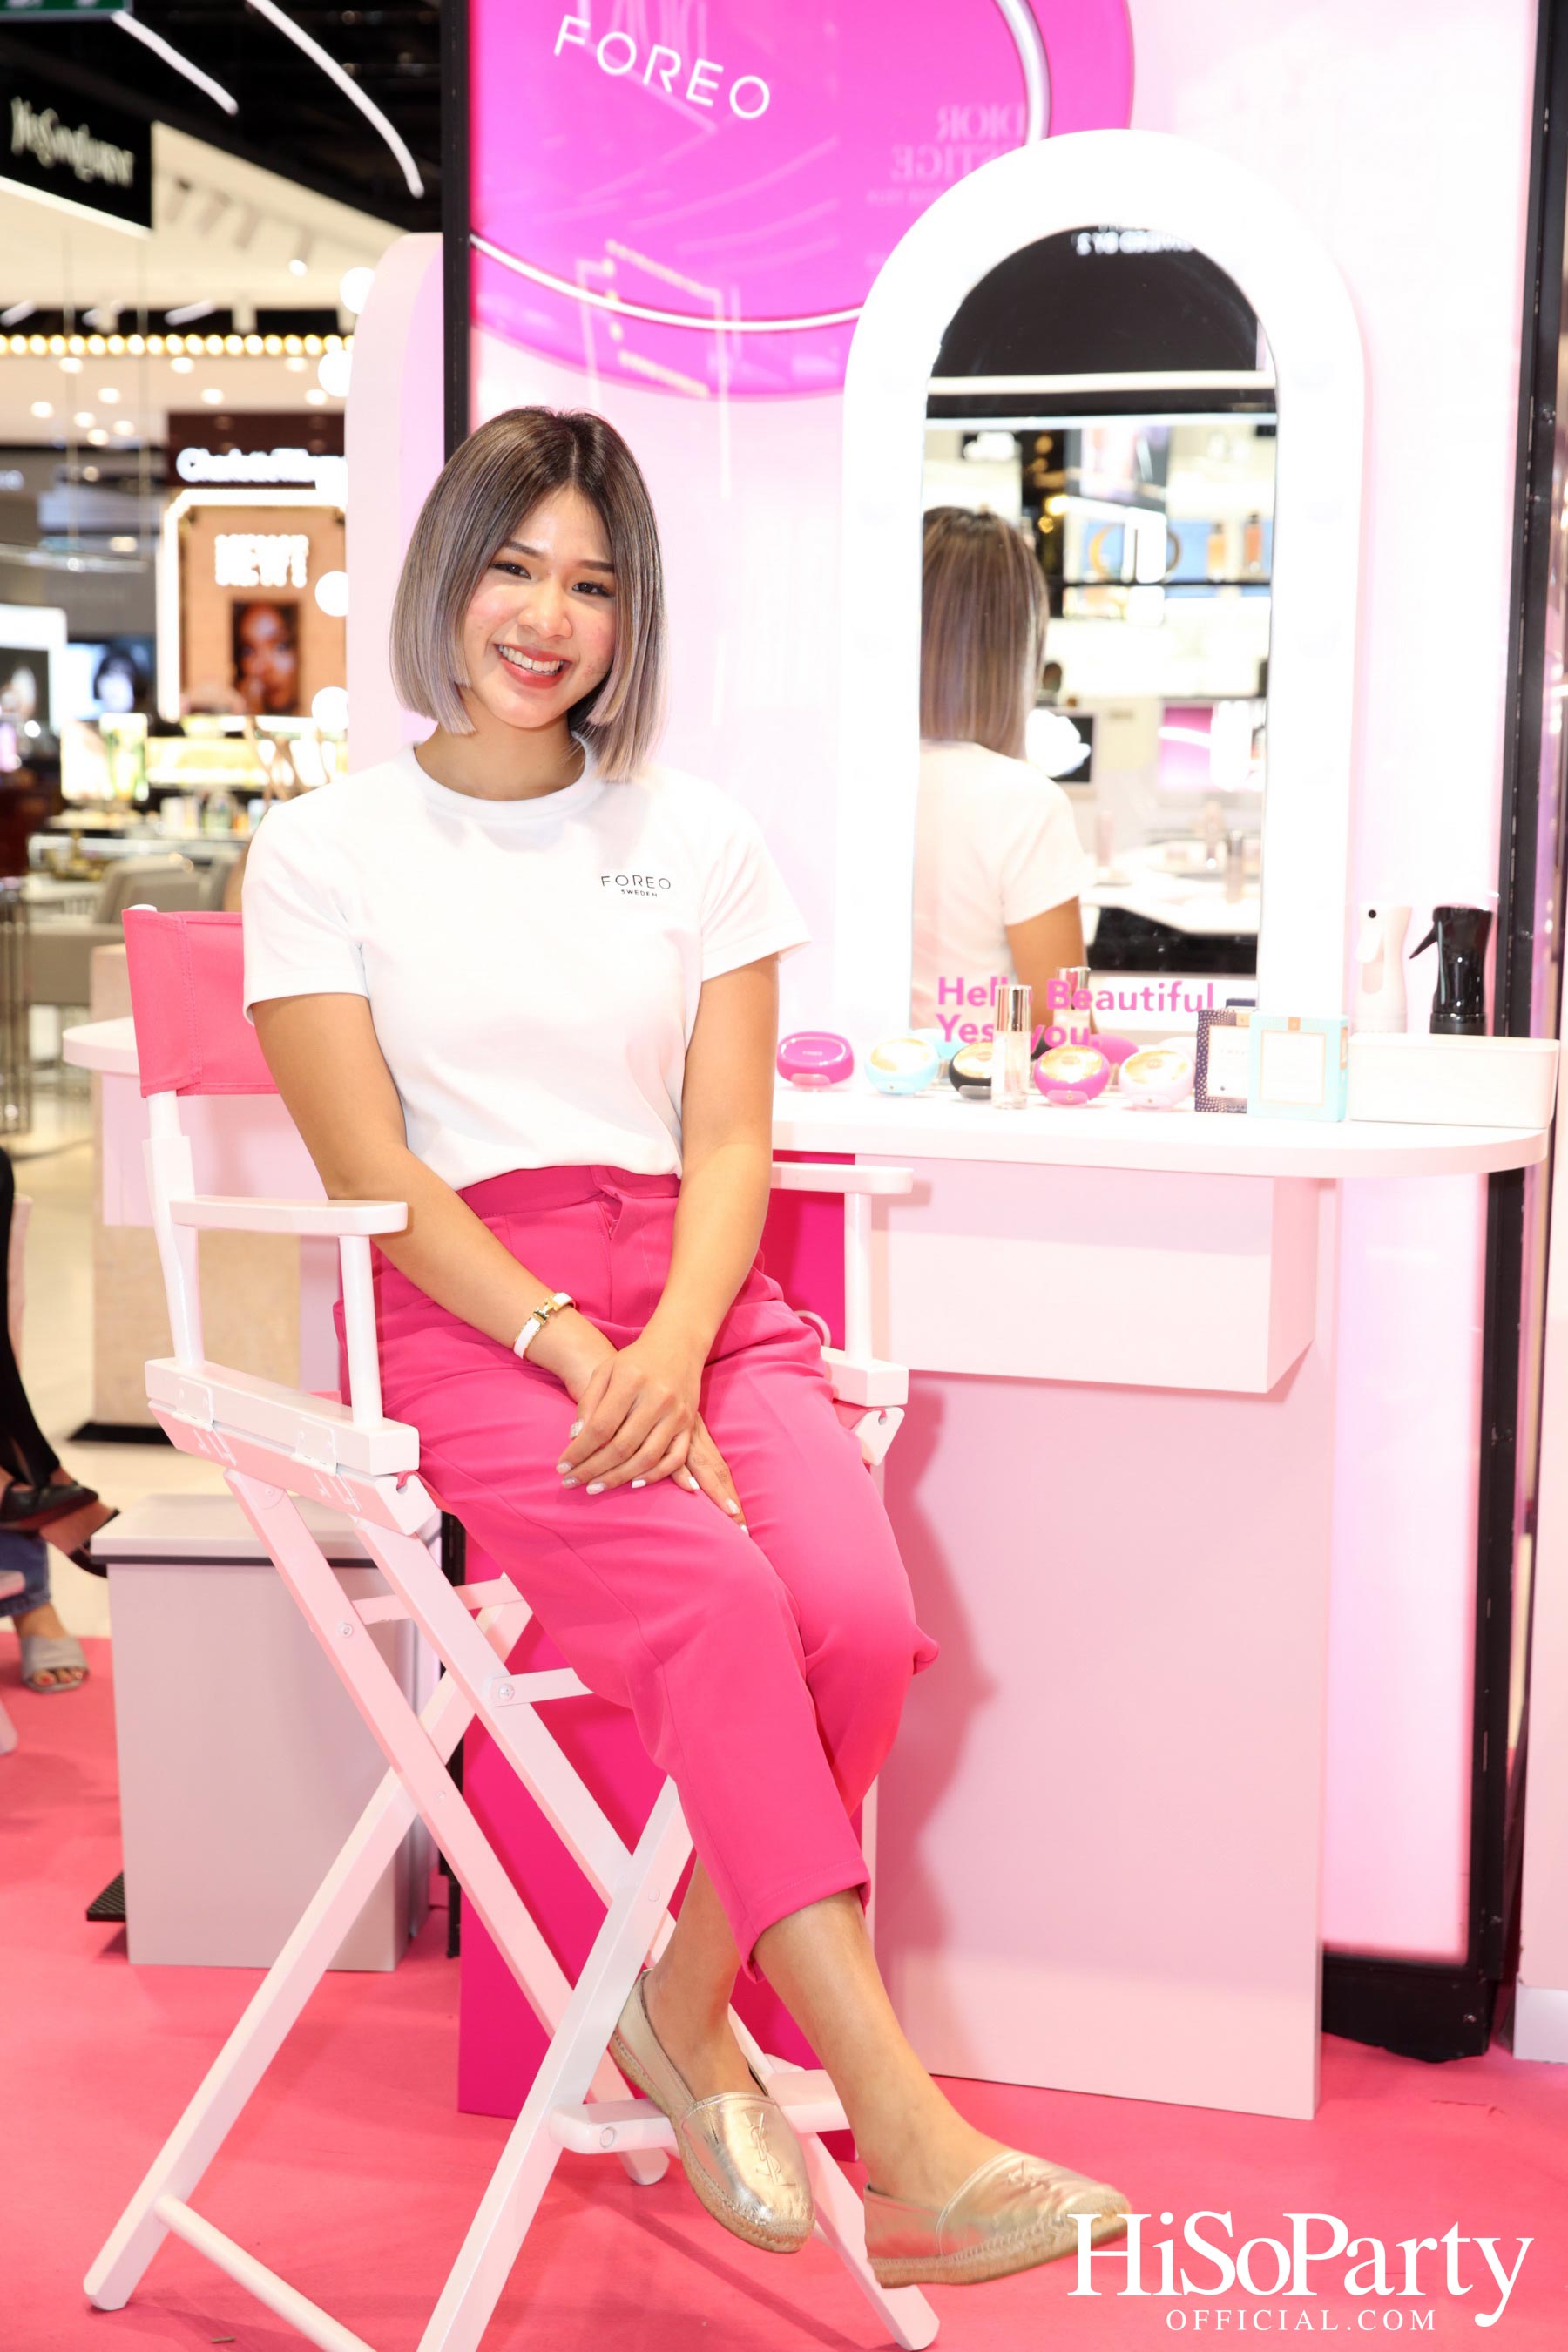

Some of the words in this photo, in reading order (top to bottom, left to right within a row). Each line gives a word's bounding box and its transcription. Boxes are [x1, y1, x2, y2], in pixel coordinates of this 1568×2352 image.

[554, 14, 770, 119] FOREO
[601, 875, 671, 889] FOREO
[938, 977, 1032, 1007] Hel
[1047, 979, 1213, 1012] Beautiful
